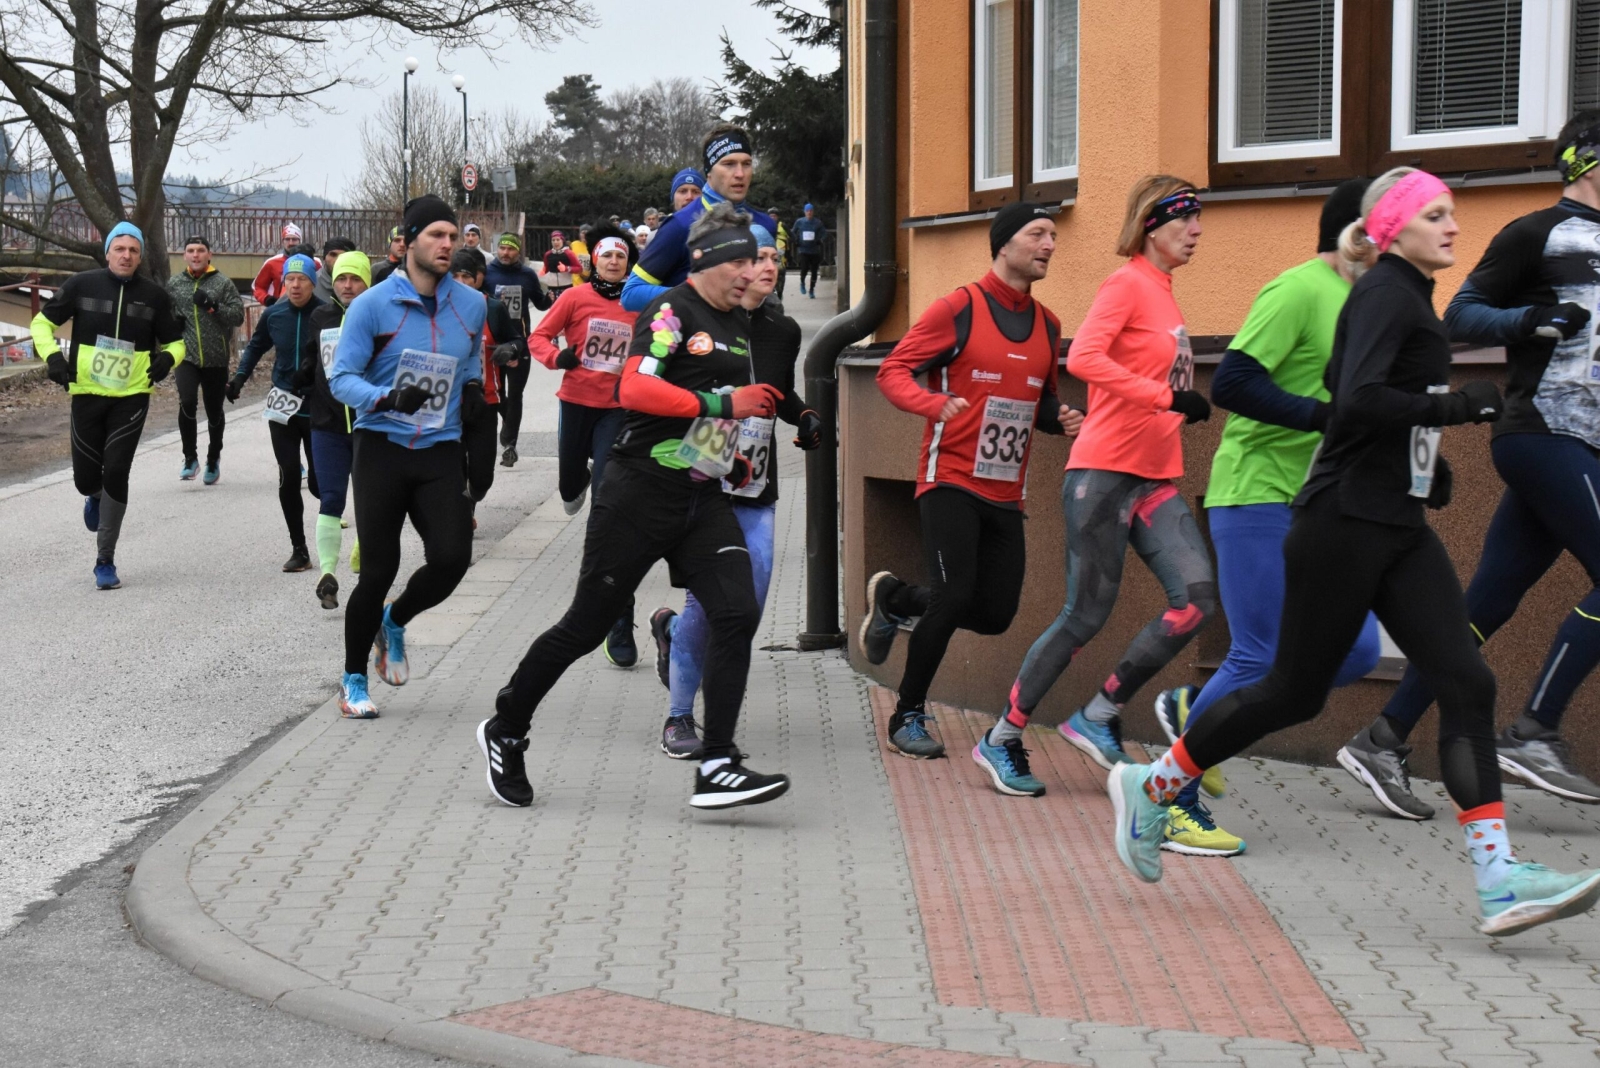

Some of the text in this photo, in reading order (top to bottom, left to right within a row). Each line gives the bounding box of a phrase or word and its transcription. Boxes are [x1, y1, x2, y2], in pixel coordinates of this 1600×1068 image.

[617, 330, 631, 338] LIGA
[403, 351, 428, 363] ZIMNÍ
[585, 335, 627, 364] 644
[92, 351, 132, 380] 673
[400, 358, 453, 376] BĚŽECKÁ LIGA
[267, 389, 299, 416] 662
[986, 407, 1020, 421] BĚŽECKÁ
[988, 398, 1014, 410] ZIMNÍ
[980, 422, 1030, 465] 333
[1414, 426, 1442, 472] 6
[737, 443, 768, 481] 13
